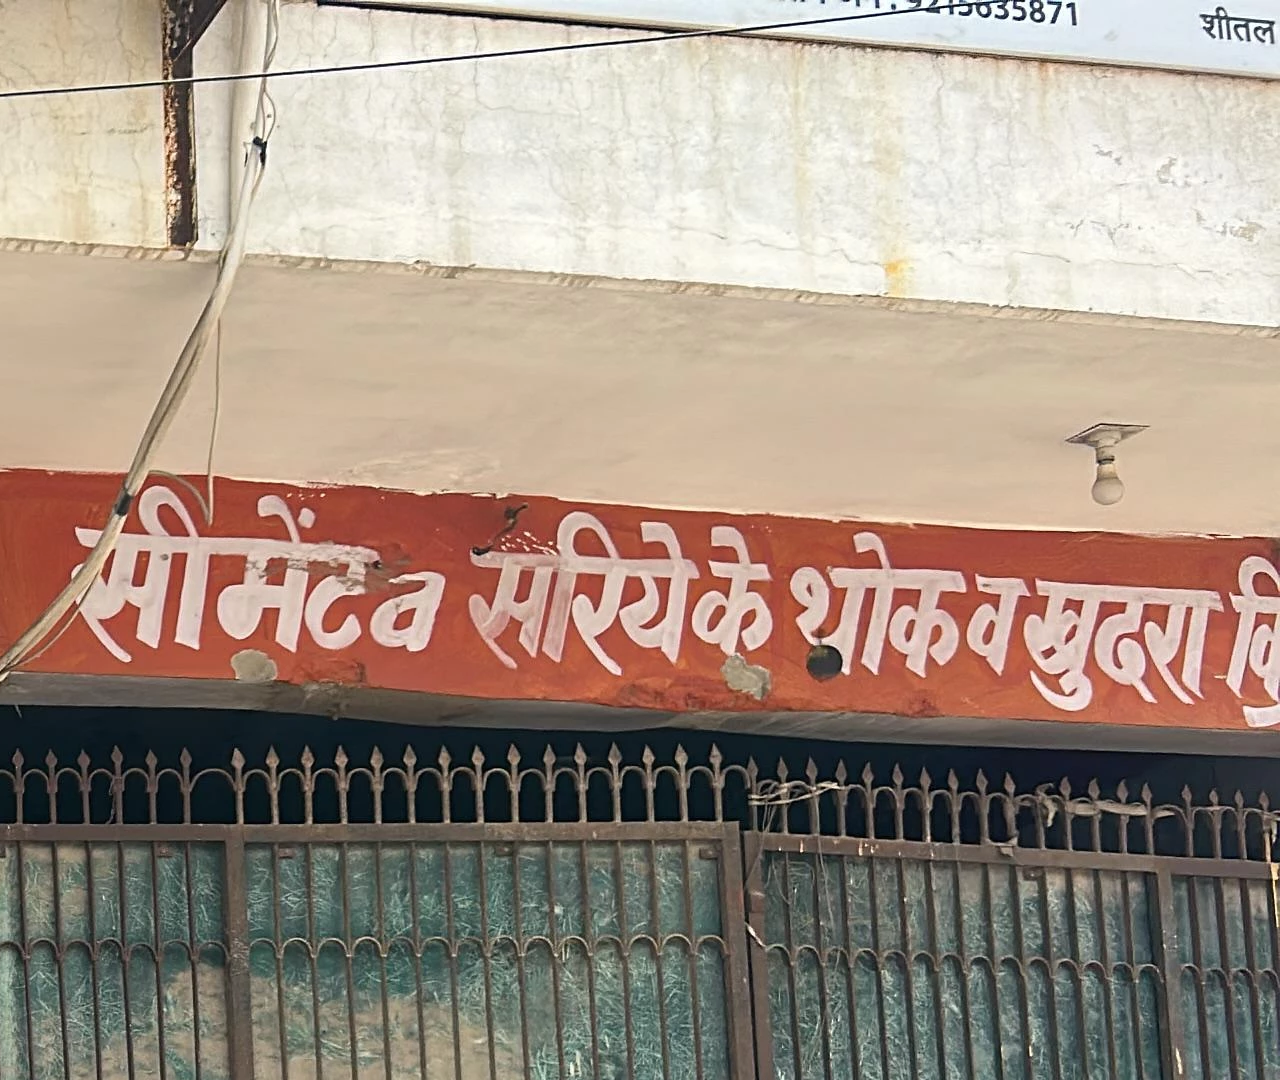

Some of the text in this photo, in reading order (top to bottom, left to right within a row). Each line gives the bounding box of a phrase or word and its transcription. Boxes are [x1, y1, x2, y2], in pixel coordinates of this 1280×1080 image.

[1199, 6, 1276, 44] शीतल
[370, 572, 446, 652] व
[691, 525, 774, 656] के
[790, 531, 967, 678] थोक
[966, 573, 1031, 677] व
[1022, 577, 1224, 712] खुदरा
